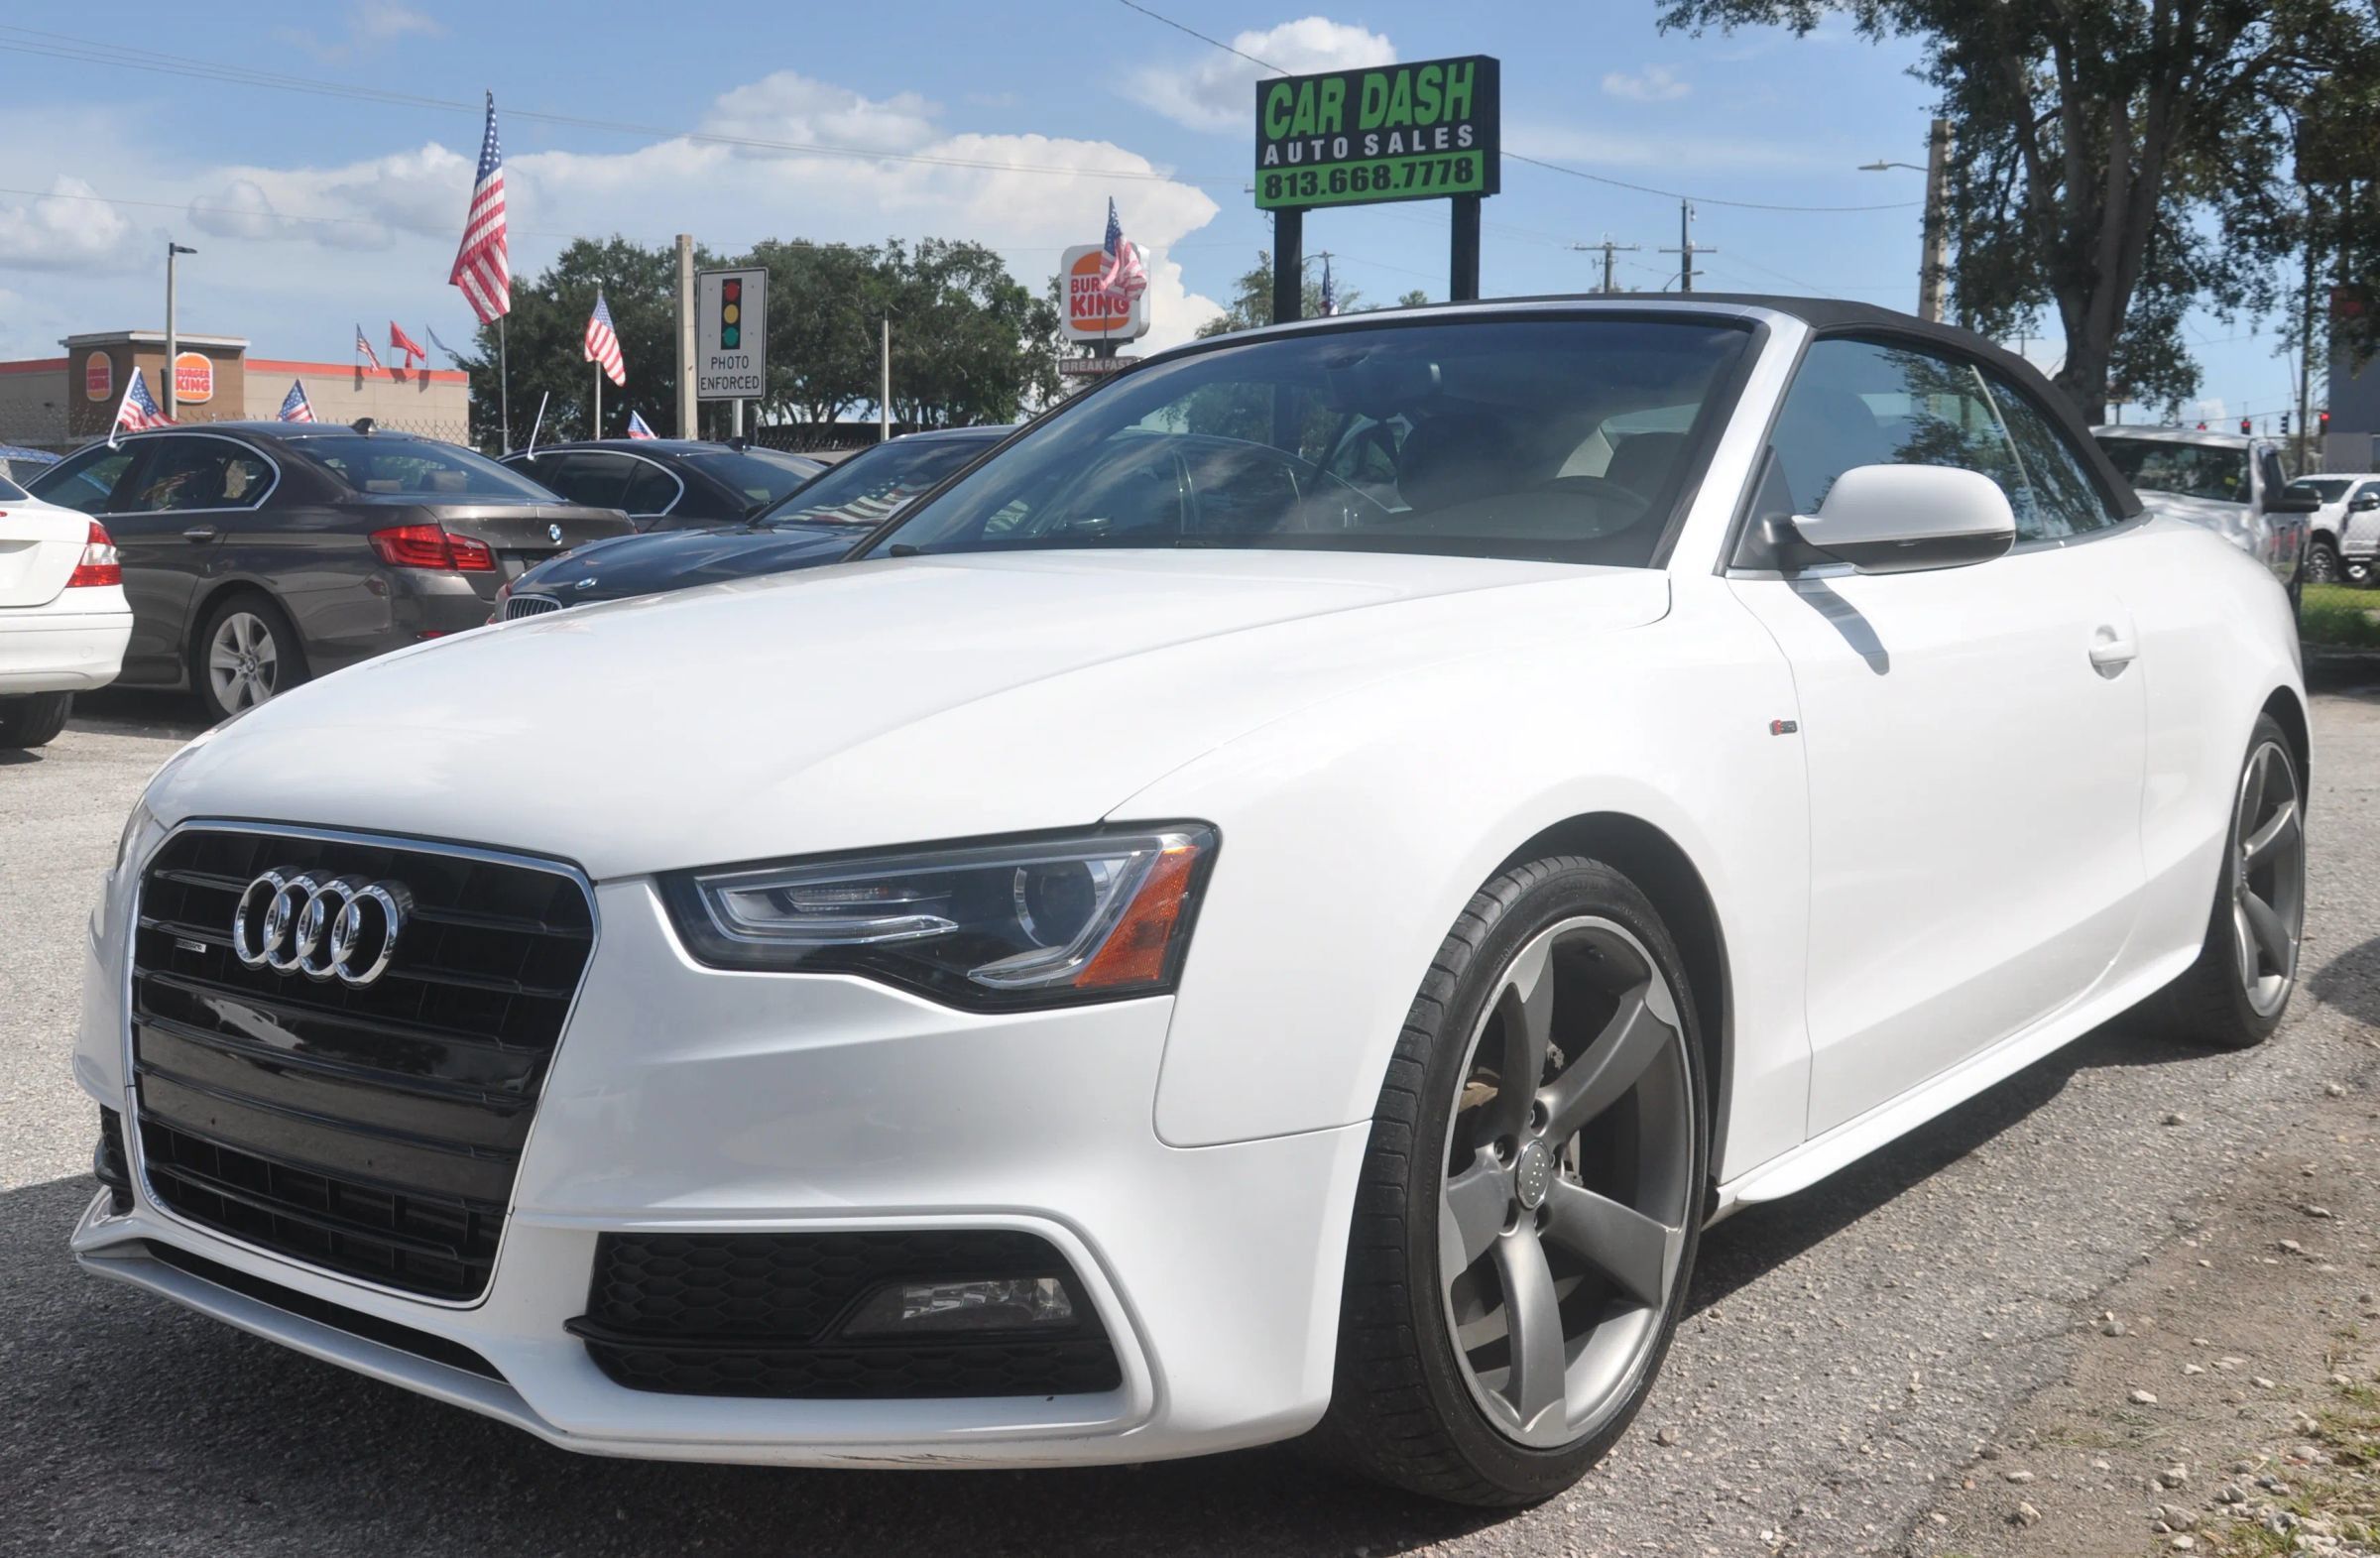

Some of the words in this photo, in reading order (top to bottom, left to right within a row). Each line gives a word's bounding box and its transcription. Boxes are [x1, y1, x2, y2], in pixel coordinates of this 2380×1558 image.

[1264, 76, 1346, 140] CAR
[1359, 61, 1475, 130] DASH
[1263, 137, 1349, 165] AUTO
[1365, 124, 1474, 156] SALES
[1264, 157, 1474, 199] 813.668.7778
[1071, 293, 1130, 317] KING
[711, 355, 749, 370] PHOTO
[175, 377, 210, 392] KING
[700, 376, 760, 390] ENFORCED
